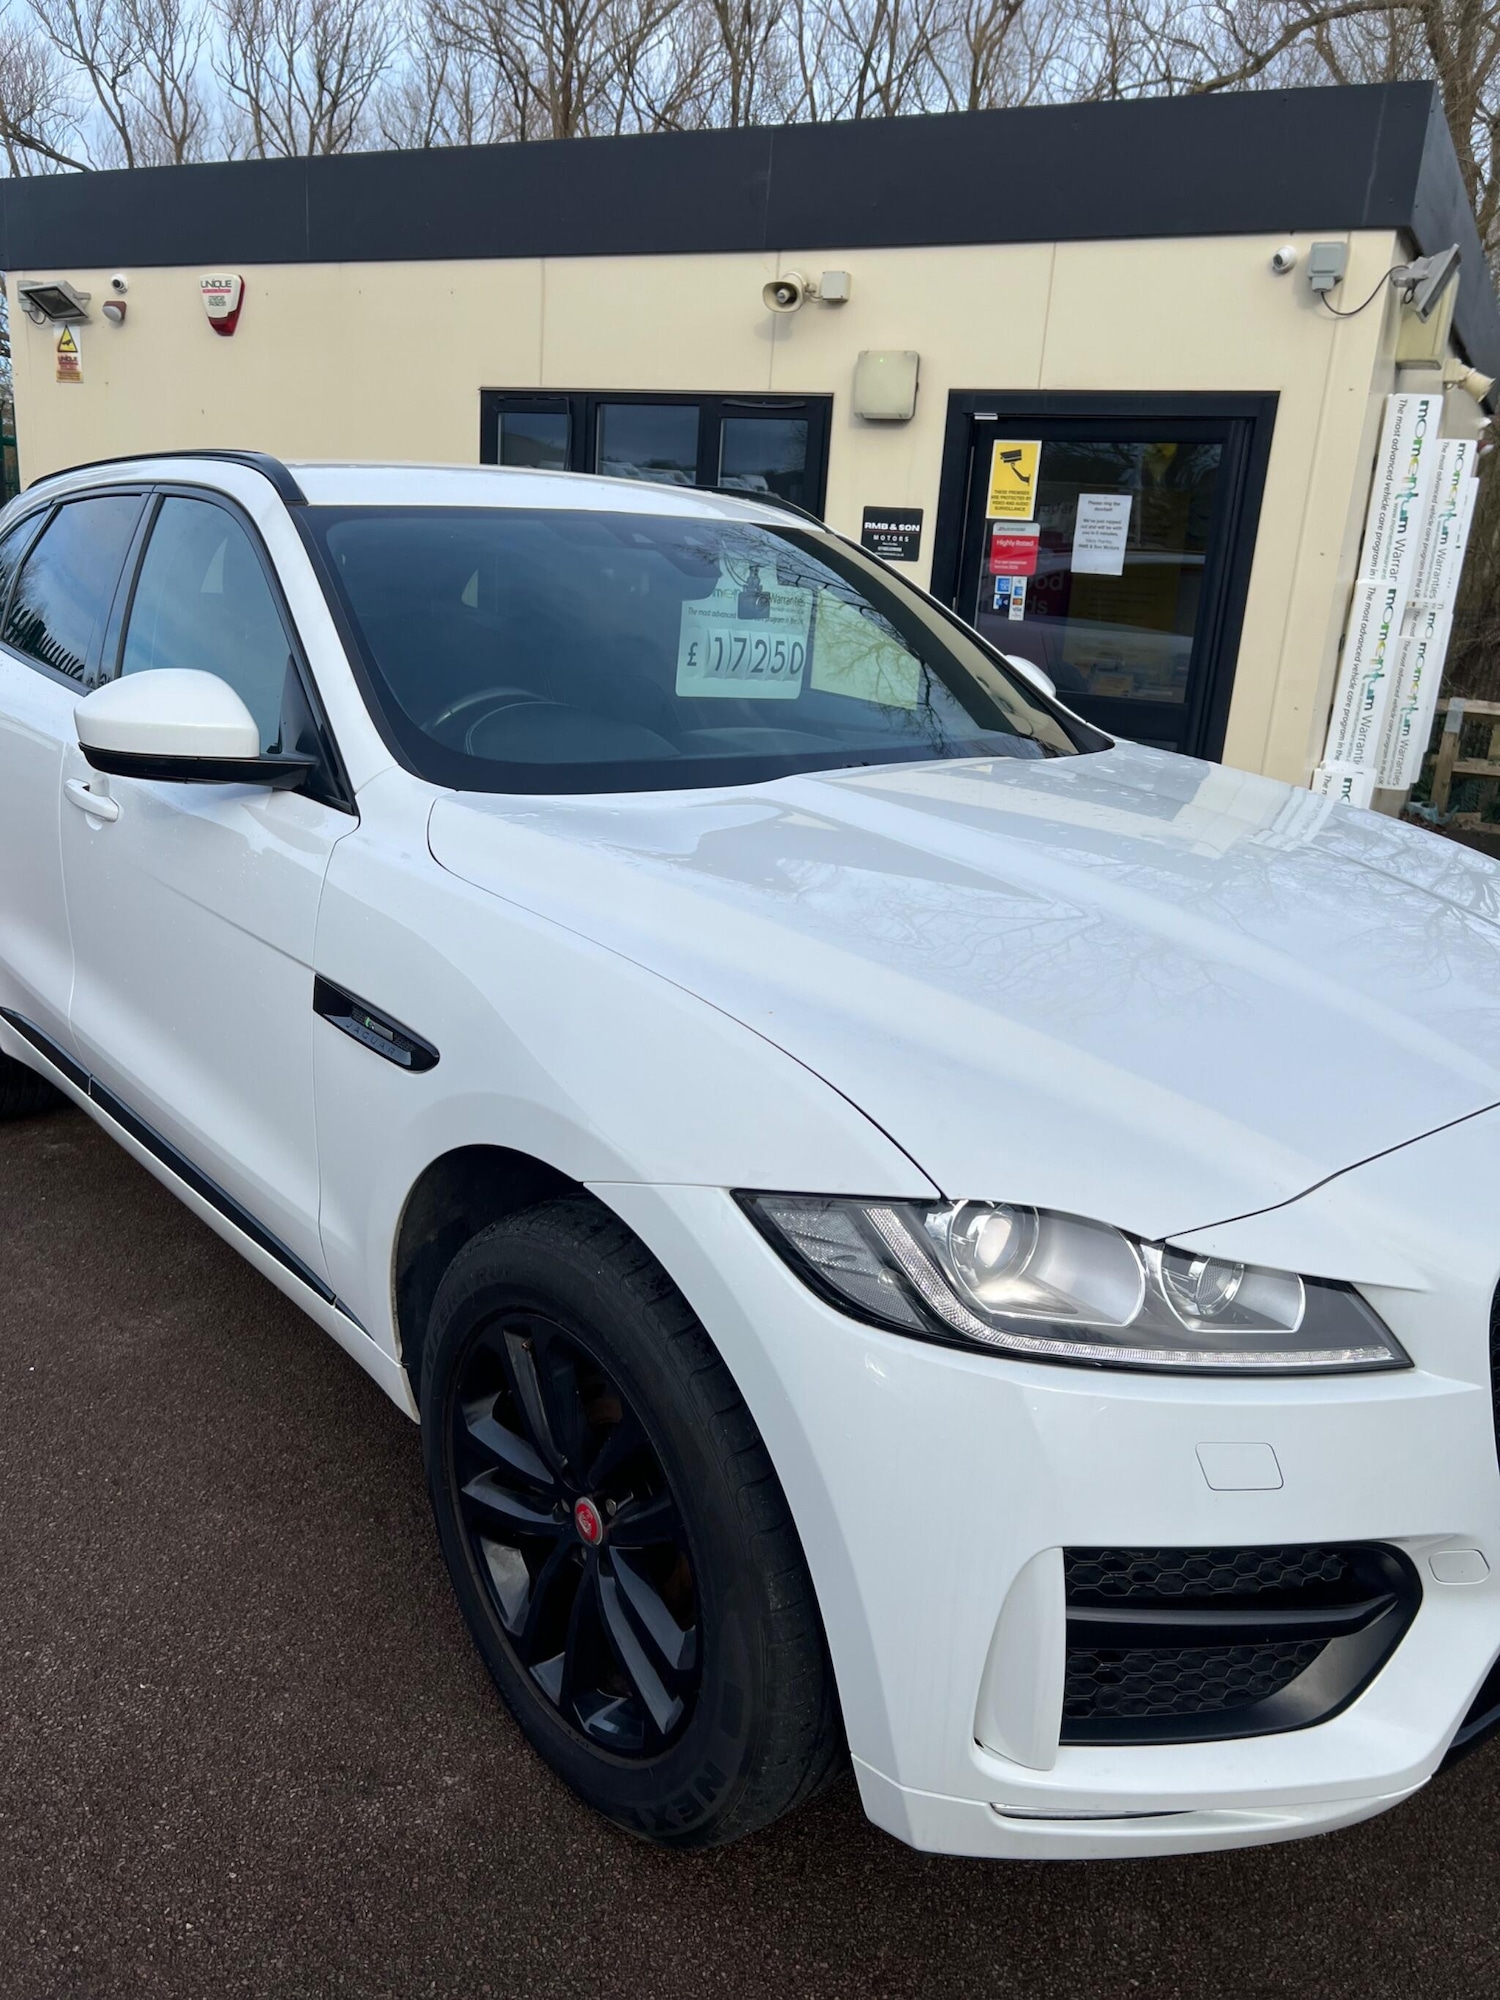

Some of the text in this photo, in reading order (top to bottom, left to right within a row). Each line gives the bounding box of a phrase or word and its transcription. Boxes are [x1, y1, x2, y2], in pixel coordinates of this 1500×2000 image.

[1397, 399, 1408, 414] The
[1393, 415, 1403, 437] most
[1441, 441, 1450, 454] The
[1386, 438, 1399, 481] advanced
[1395, 400, 1430, 533] momentum
[1438, 454, 1446, 471] most
[1381, 482, 1391, 511] vehicle
[1432, 471, 1442, 504] advanced
[1438, 443, 1466, 545] momentum
[1377, 512, 1386, 531] care
[1427, 505, 1437, 526] vehicle
[873, 534, 909, 542] MOTORS
[996, 539, 1015, 547] Highly
[1425, 527, 1433, 542] care
[1371, 532, 1382, 567] program
[1420, 542, 1429, 568] program
[1415, 577, 1423, 588] the
[1429, 548, 1447, 599] Warranties
[1366, 586, 1376, 603] The
[1413, 589, 1421, 598] UK
[688, 606, 698, 616] The
[699, 608, 711, 617] most
[1362, 603, 1371, 622] most
[1355, 622, 1367, 663] advanced
[1362, 588, 1397, 711] momentum
[1402, 640, 1411, 651] The
[686, 636, 804, 675] £ 17250
[1399, 652, 1407, 667] most
[1350, 663, 1360, 690] vehicle
[1394, 668, 1404, 698] advanced
[1346, 690, 1354, 709] care
[1400, 642, 1427, 736] momentum
[1390, 698, 1398, 719] vehicle
[1338, 708, 1350, 741] program
[1383, 732, 1391, 759] program
[1392, 739, 1409, 786] Warranties
[1324, 775, 1332, 789] The
[345, 1021, 396, 1056] JAGUAR
